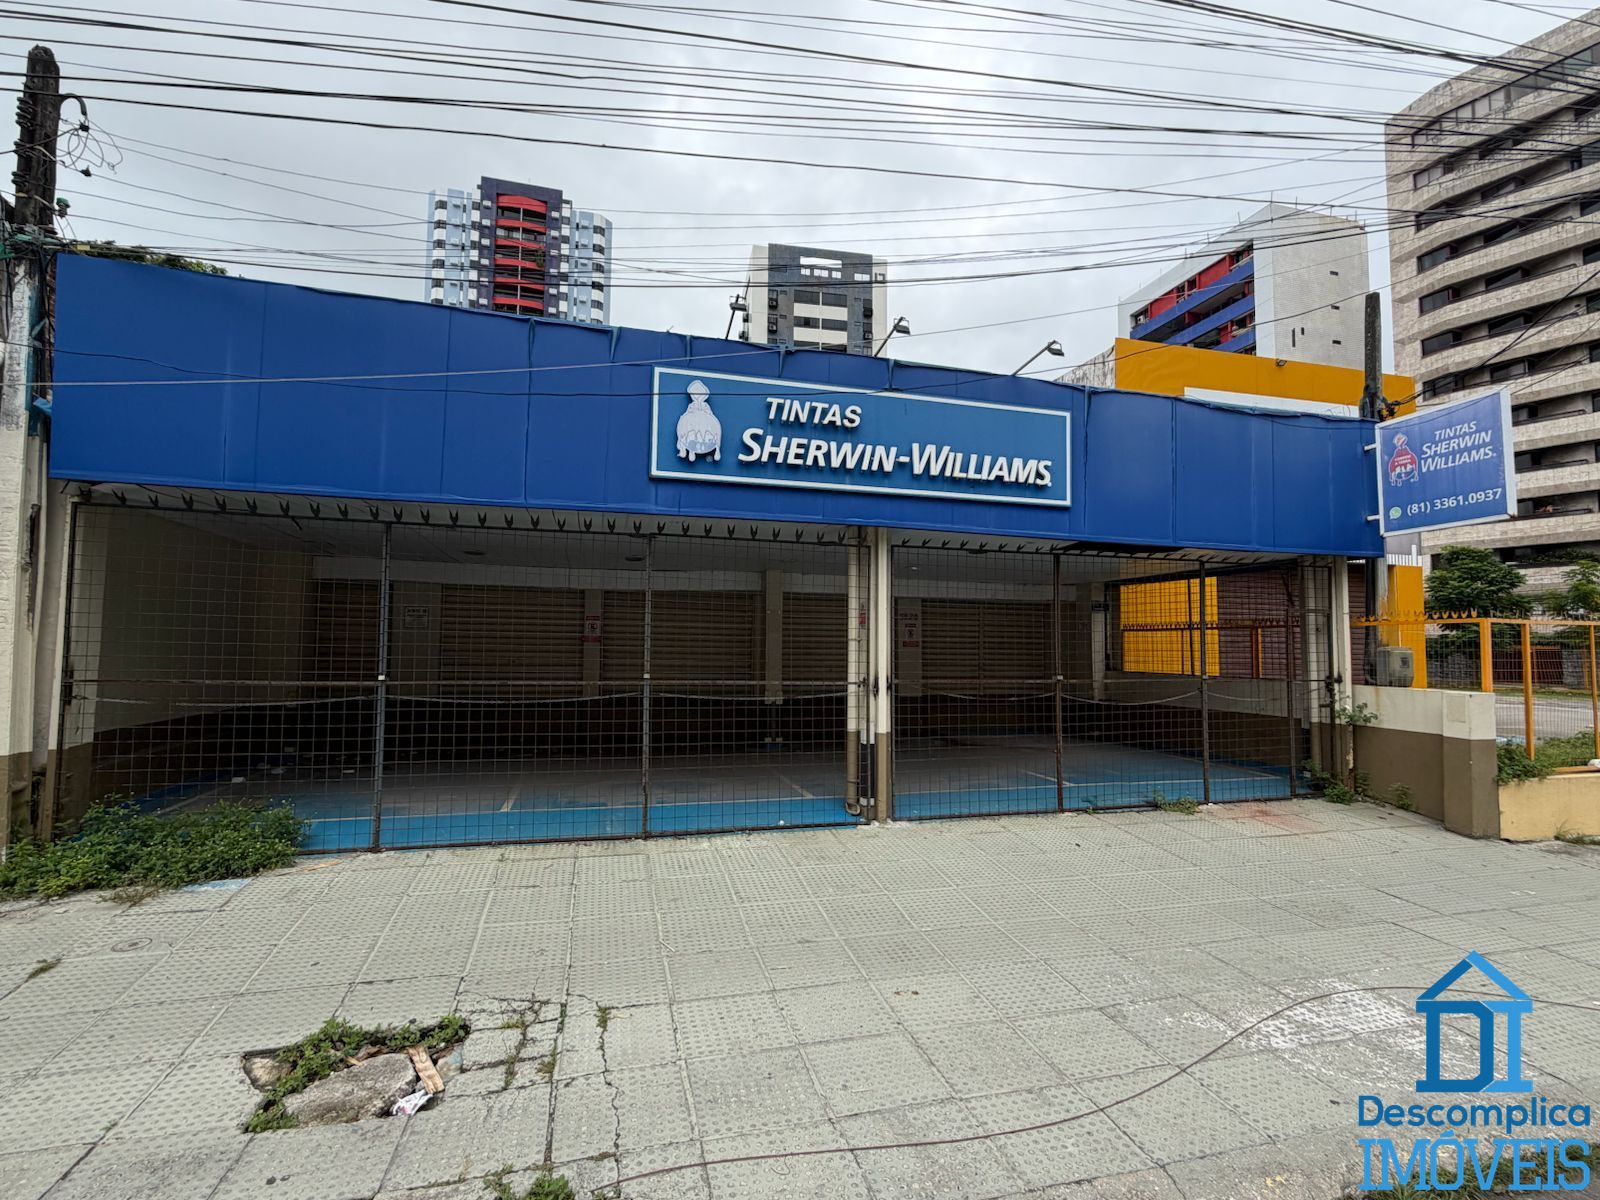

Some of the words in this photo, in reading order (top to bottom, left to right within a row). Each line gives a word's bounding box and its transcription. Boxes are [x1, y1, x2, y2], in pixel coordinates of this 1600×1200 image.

[765, 397, 862, 428] TINTAS
[1421, 430, 1492, 457] SHERWIN
[1434, 421, 1477, 441] TINTAS
[738, 428, 1052, 487] SHERWIN-WILLIAMS
[1420, 446, 1493, 473] WILLIAMS
[1407, 500, 1430, 516] (81)
[1434, 488, 1502, 510] 3361.0937
